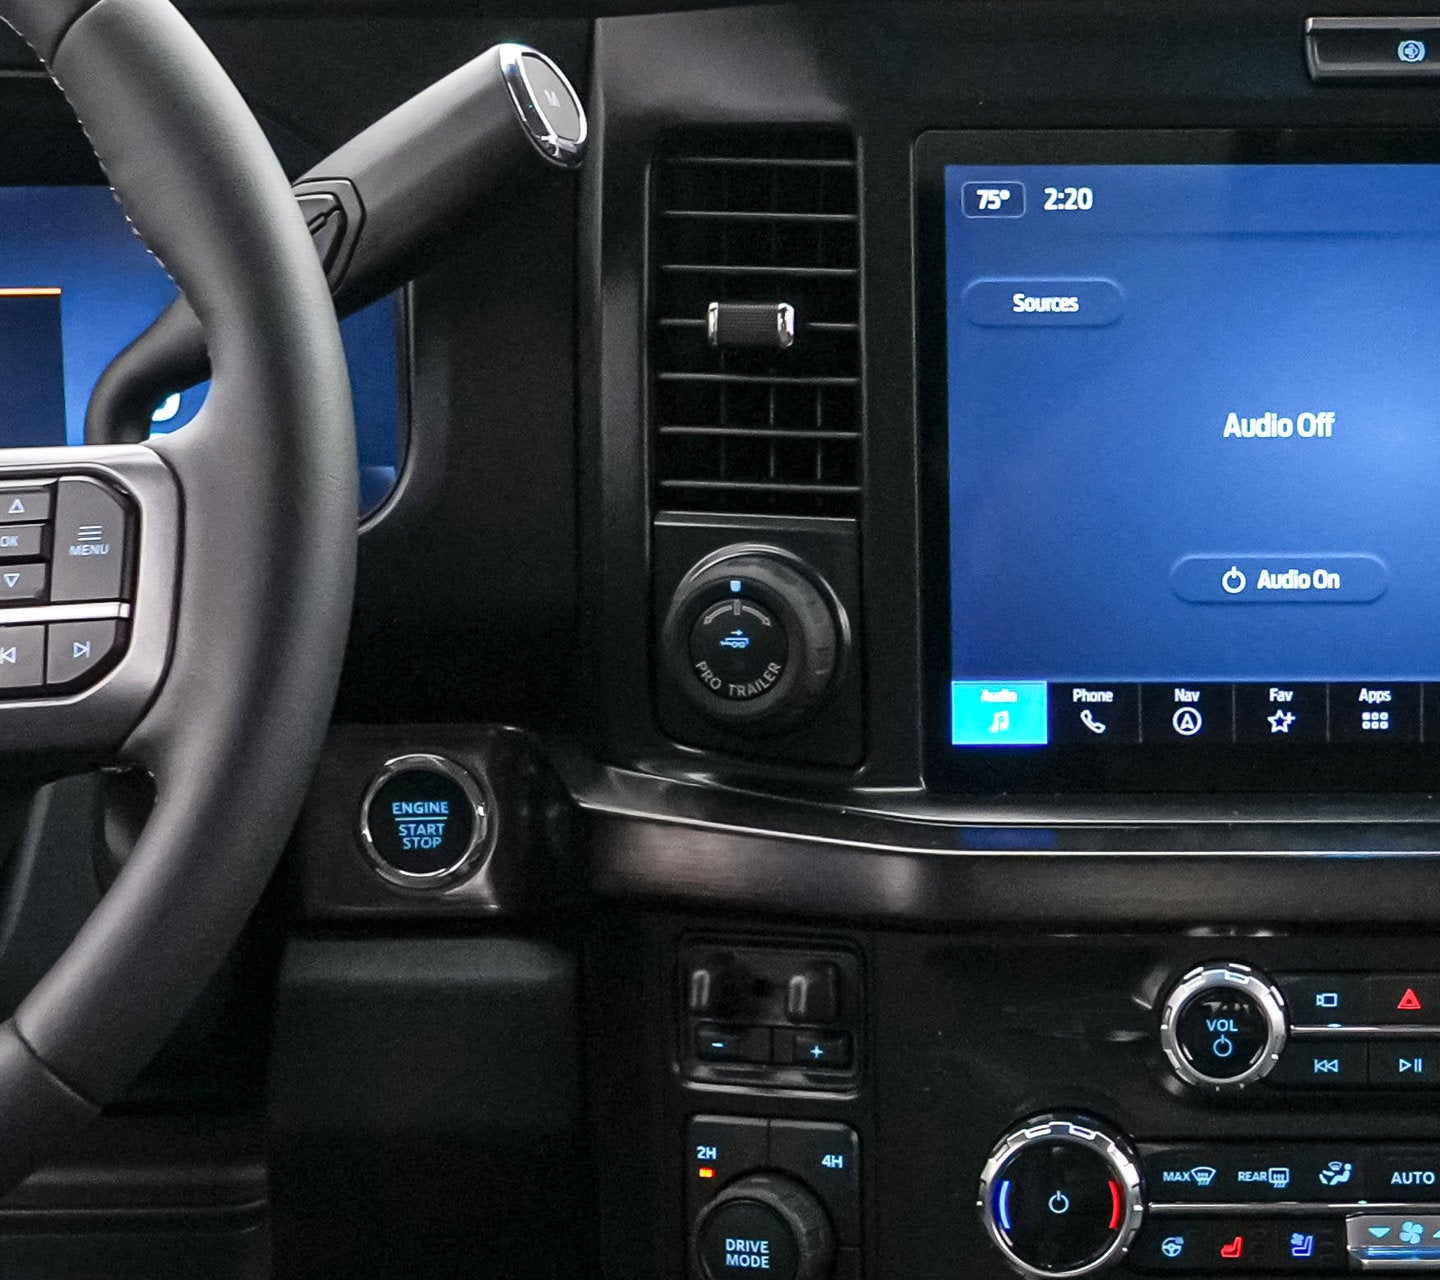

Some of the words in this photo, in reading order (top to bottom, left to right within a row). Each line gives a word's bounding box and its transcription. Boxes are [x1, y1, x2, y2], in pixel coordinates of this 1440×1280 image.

[1043, 187, 1093, 210] 2:20
[1012, 293, 1079, 314] Sources
[1222, 411, 1292, 438] Audio
[1297, 411, 1335, 438] Off
[0, 536, 19, 548] OK
[68, 543, 110, 556] MENU
[1256, 569, 1310, 590] Audio
[1313, 569, 1341, 590] On
[695, 660, 722, 690] PRO
[728, 662, 782, 697] TRAILER
[982, 688, 1017, 702] Audio
[1072, 687, 1113, 703] Phone
[1174, 687, 1199, 703] Nav
[1269, 687, 1293, 703] Fav
[1359, 687, 1391, 706] Apps
[392, 800, 449, 815] ENGINE
[398, 823, 446, 837] START
[402, 836, 442, 850] STOP
[1205, 1017, 1240, 1034] VOL
[696, 1146, 718, 1160] 2H
[821, 1154, 844, 1168] 4H
[1162, 1170, 1191, 1184] MAX
[1237, 1170, 1269, 1184] REAR
[1390, 1170, 1436, 1186] AUTO
[724, 1239, 770, 1254] DRIVE
[724, 1254, 770, 1269] MODE
